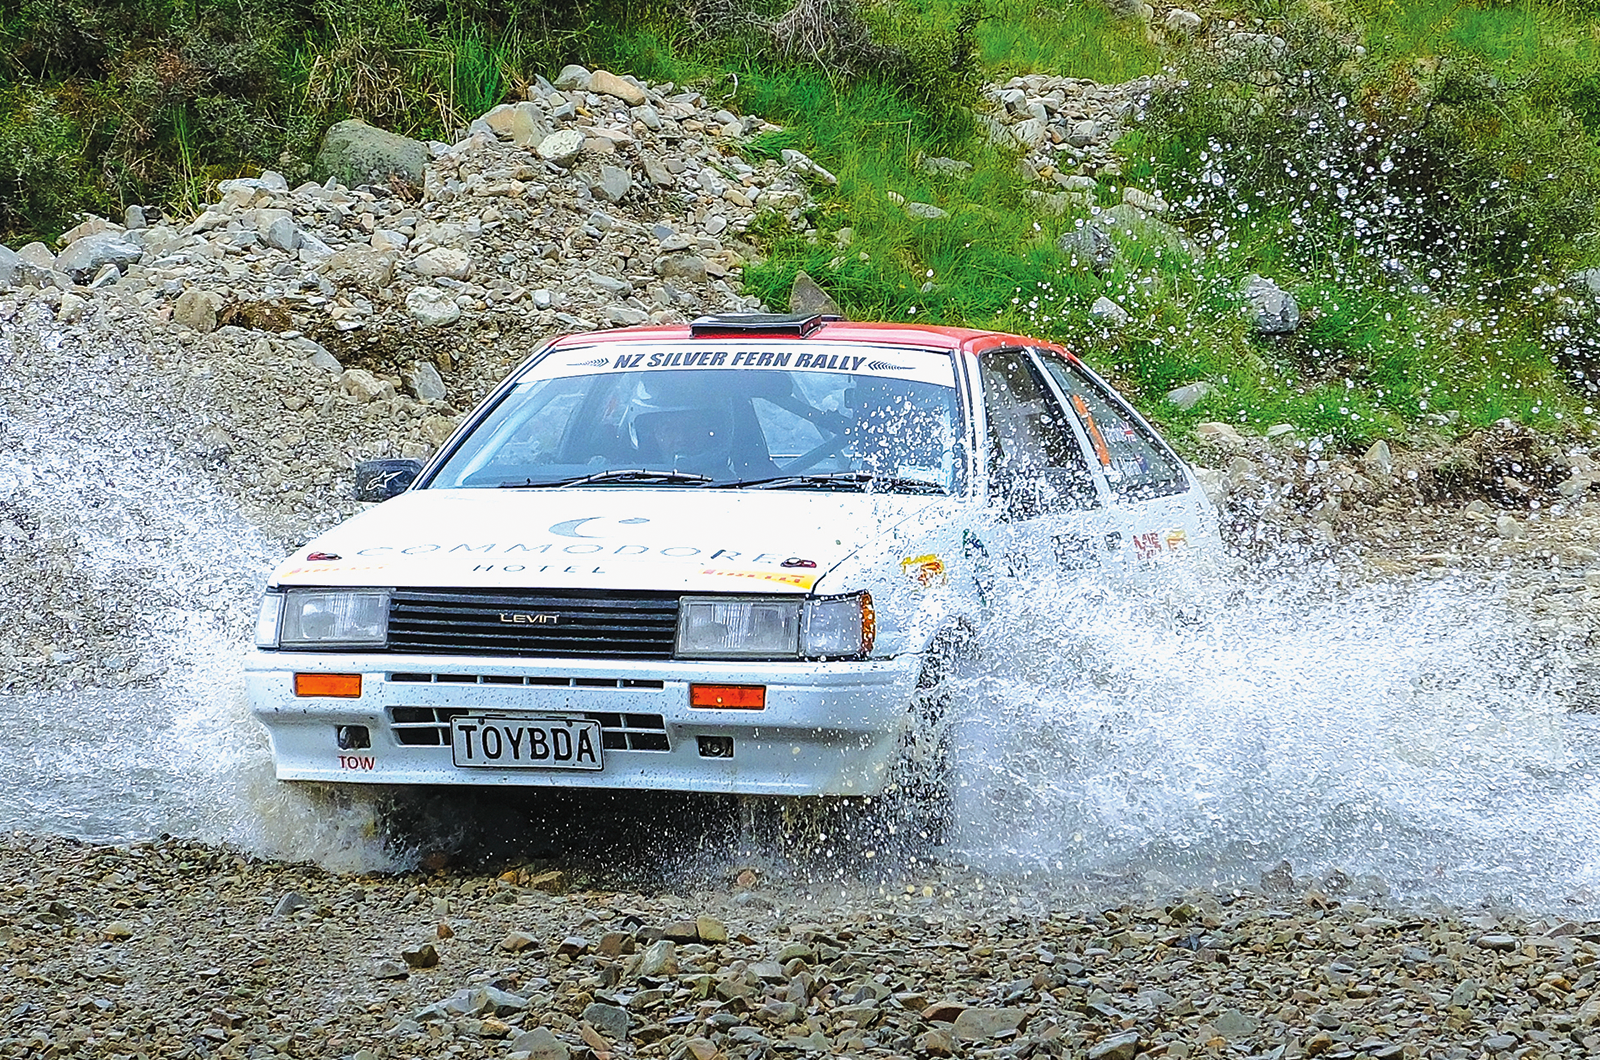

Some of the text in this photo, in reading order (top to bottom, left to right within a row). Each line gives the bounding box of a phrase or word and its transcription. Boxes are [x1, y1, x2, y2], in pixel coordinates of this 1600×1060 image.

[613, 351, 867, 371] NZ SILVER FERN RALLY
[356, 543, 784, 564] COMMODORE
[472, 564, 606, 574] HOTEL
[499, 612, 560, 624] LEVIN
[457, 724, 597, 763] TOYBDA
[336, 755, 376, 771] TOW
